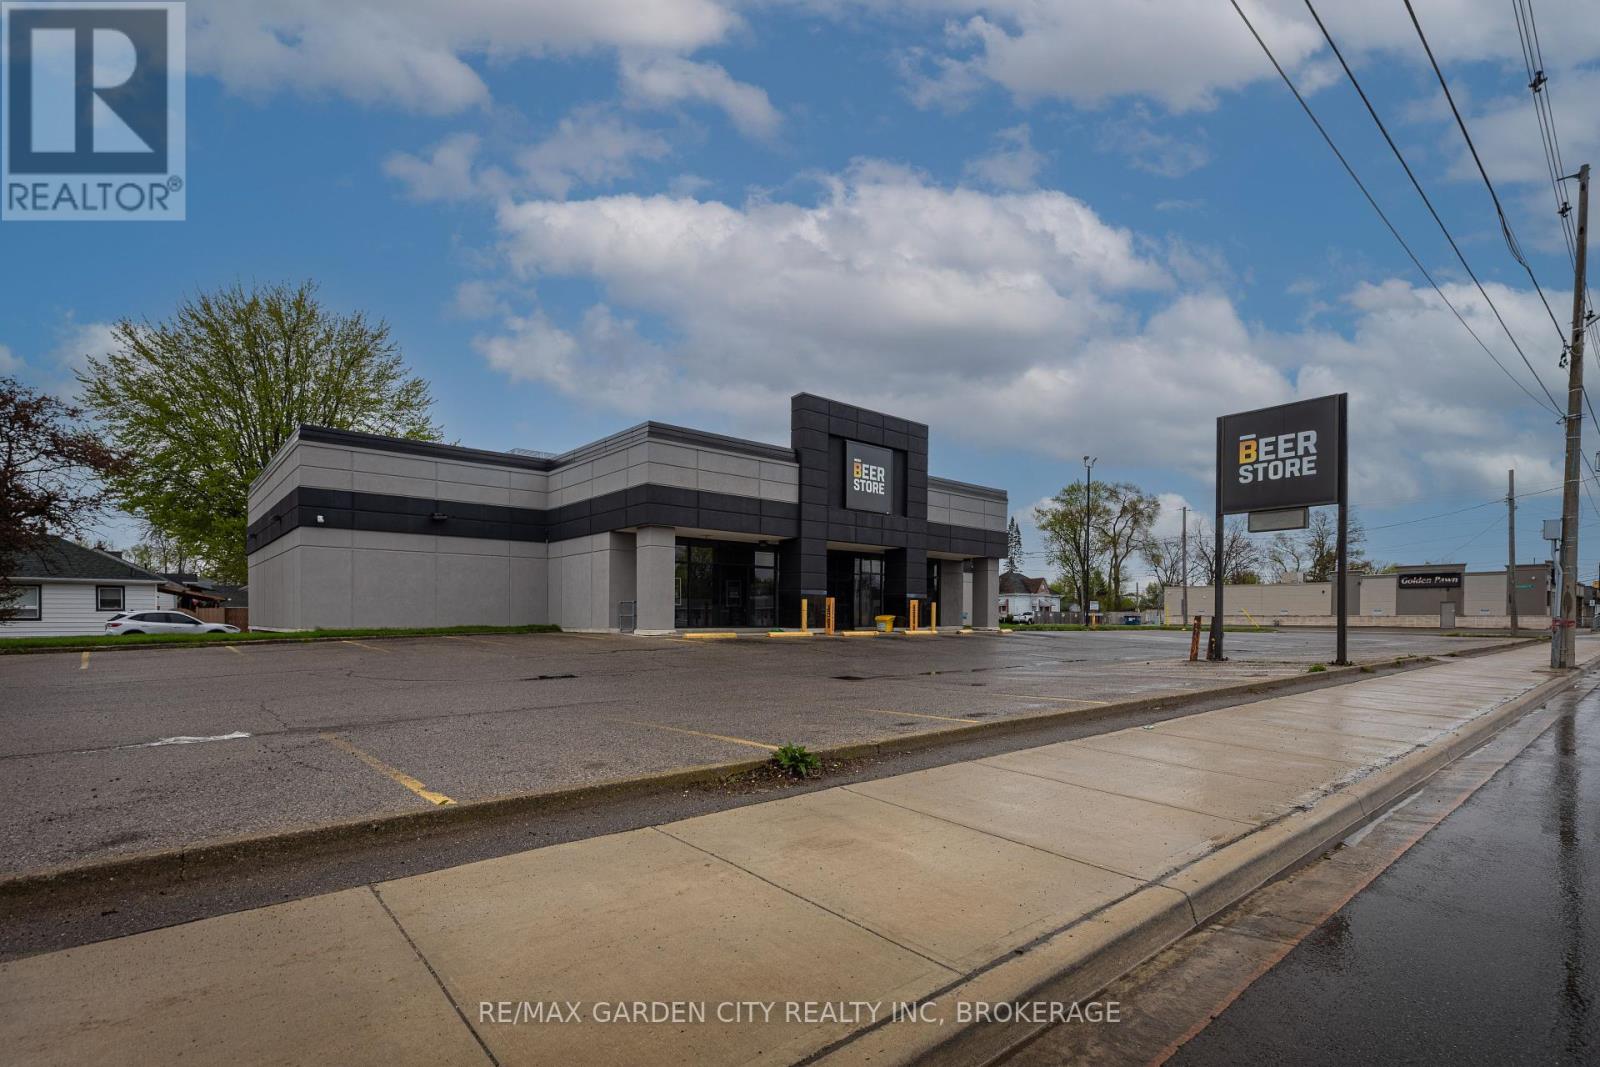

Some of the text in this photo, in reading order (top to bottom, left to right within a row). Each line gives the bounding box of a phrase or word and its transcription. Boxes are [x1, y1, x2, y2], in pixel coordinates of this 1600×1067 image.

[1238, 430, 1318, 465] BEER
[853, 462, 885, 482] BEER
[1238, 455, 1318, 484] STORE
[853, 478, 885, 495] STORE
[1401, 576, 1459, 584] Golden Pawn
